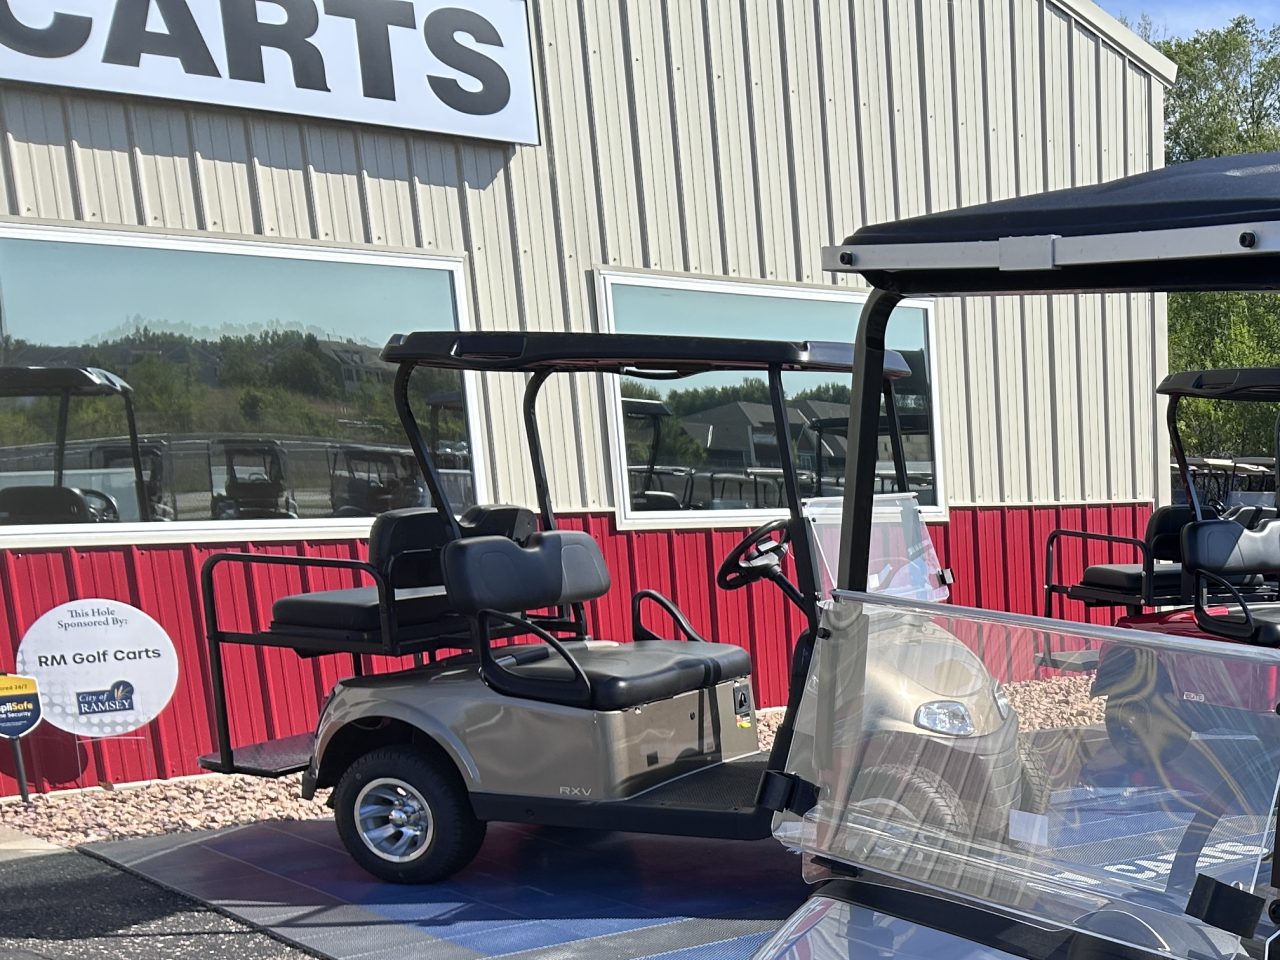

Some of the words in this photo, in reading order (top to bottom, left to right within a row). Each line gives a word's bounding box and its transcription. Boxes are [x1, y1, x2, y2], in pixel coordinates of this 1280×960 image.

[67, 608, 90, 619] This
[91, 606, 115, 617] Hole
[57, 618, 109, 631] Sponsored
[38, 653, 67, 667] RM
[72, 650, 109, 665] Golf
[113, 648, 161, 661] Carts
[79, 694, 97, 704] City
[98, 693, 109, 702] of
[0, 701, 33, 713] pliSafe
[80, 700, 131, 713] RAMSEY
[559, 786, 592, 796] RXV
